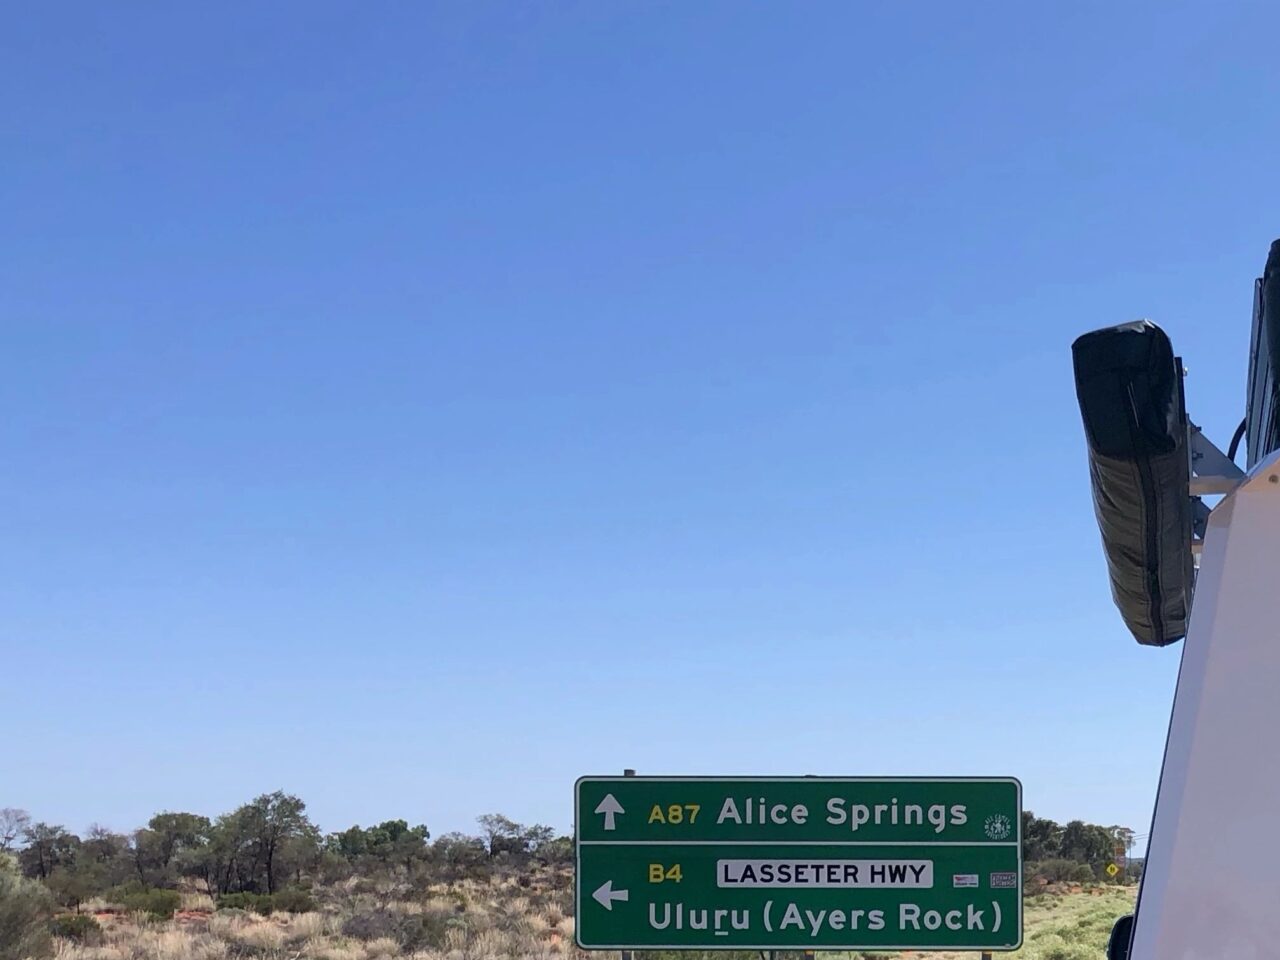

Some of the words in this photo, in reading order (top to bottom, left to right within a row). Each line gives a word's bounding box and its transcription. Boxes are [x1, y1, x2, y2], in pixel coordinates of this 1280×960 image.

[647, 804, 700, 824] A87
[716, 796, 809, 825] Alice
[825, 796, 968, 833] Springs
[648, 863, 683, 884] B4
[723, 864, 859, 884] LASSETER
[869, 864, 926, 884] HWY
[763, 900, 886, 936] (Ayers
[899, 900, 1002, 933] Rock)
